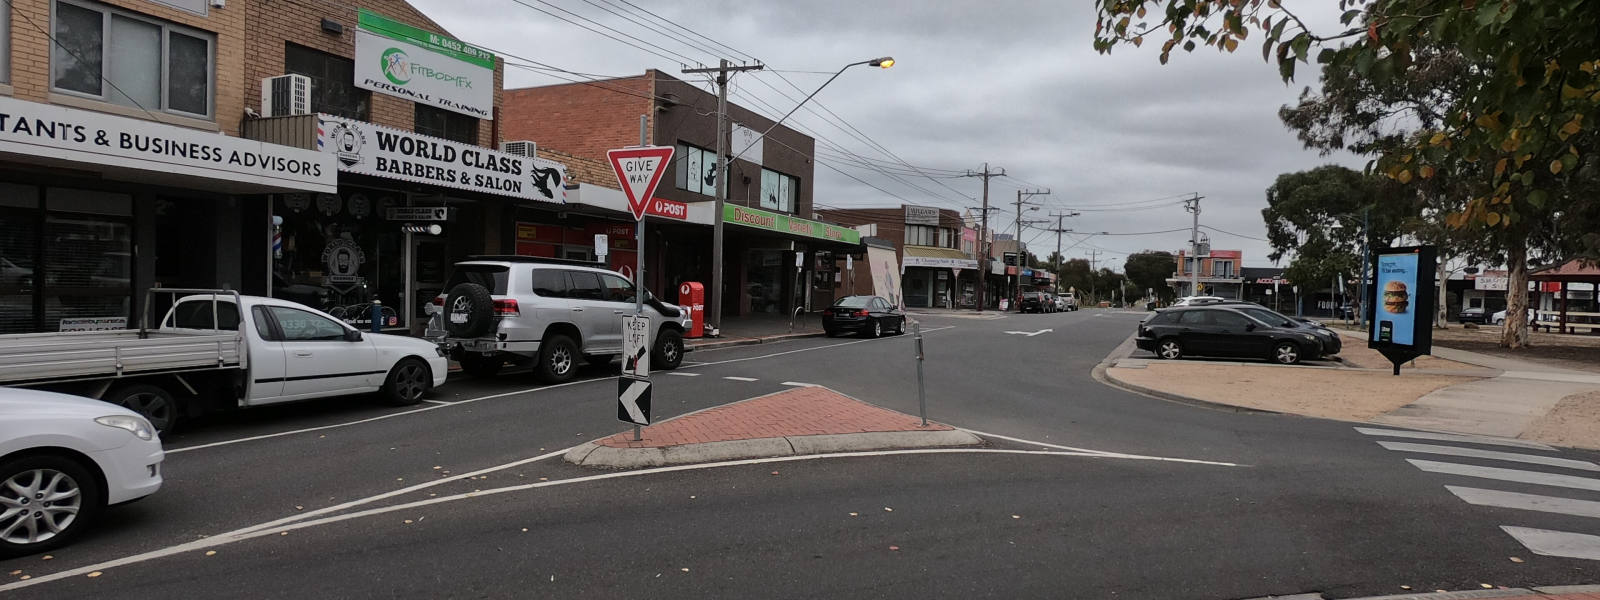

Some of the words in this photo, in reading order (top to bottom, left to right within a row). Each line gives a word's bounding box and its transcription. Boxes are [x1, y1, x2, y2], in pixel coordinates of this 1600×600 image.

[442, 39, 461, 52] 0452
[364, 77, 432, 102] PERSONAL
[438, 97, 488, 117] TRAINING
[94, 129, 111, 147] &
[119, 131, 223, 163] BUSINESS
[228, 150, 322, 178] ADVISORS
[376, 130, 457, 163] WORLD
[461, 149, 522, 176] CLASS
[376, 156, 456, 183] BARBERS
[460, 171, 471, 185] &
[475, 174, 522, 194] SALON
[626, 160, 653, 172] GIVE
[630, 174, 650, 185] WAY
[664, 202, 685, 216] POST
[734, 207, 775, 228] Discount
[788, 216, 814, 236] Variety
[627, 321, 646, 332] KEEP
